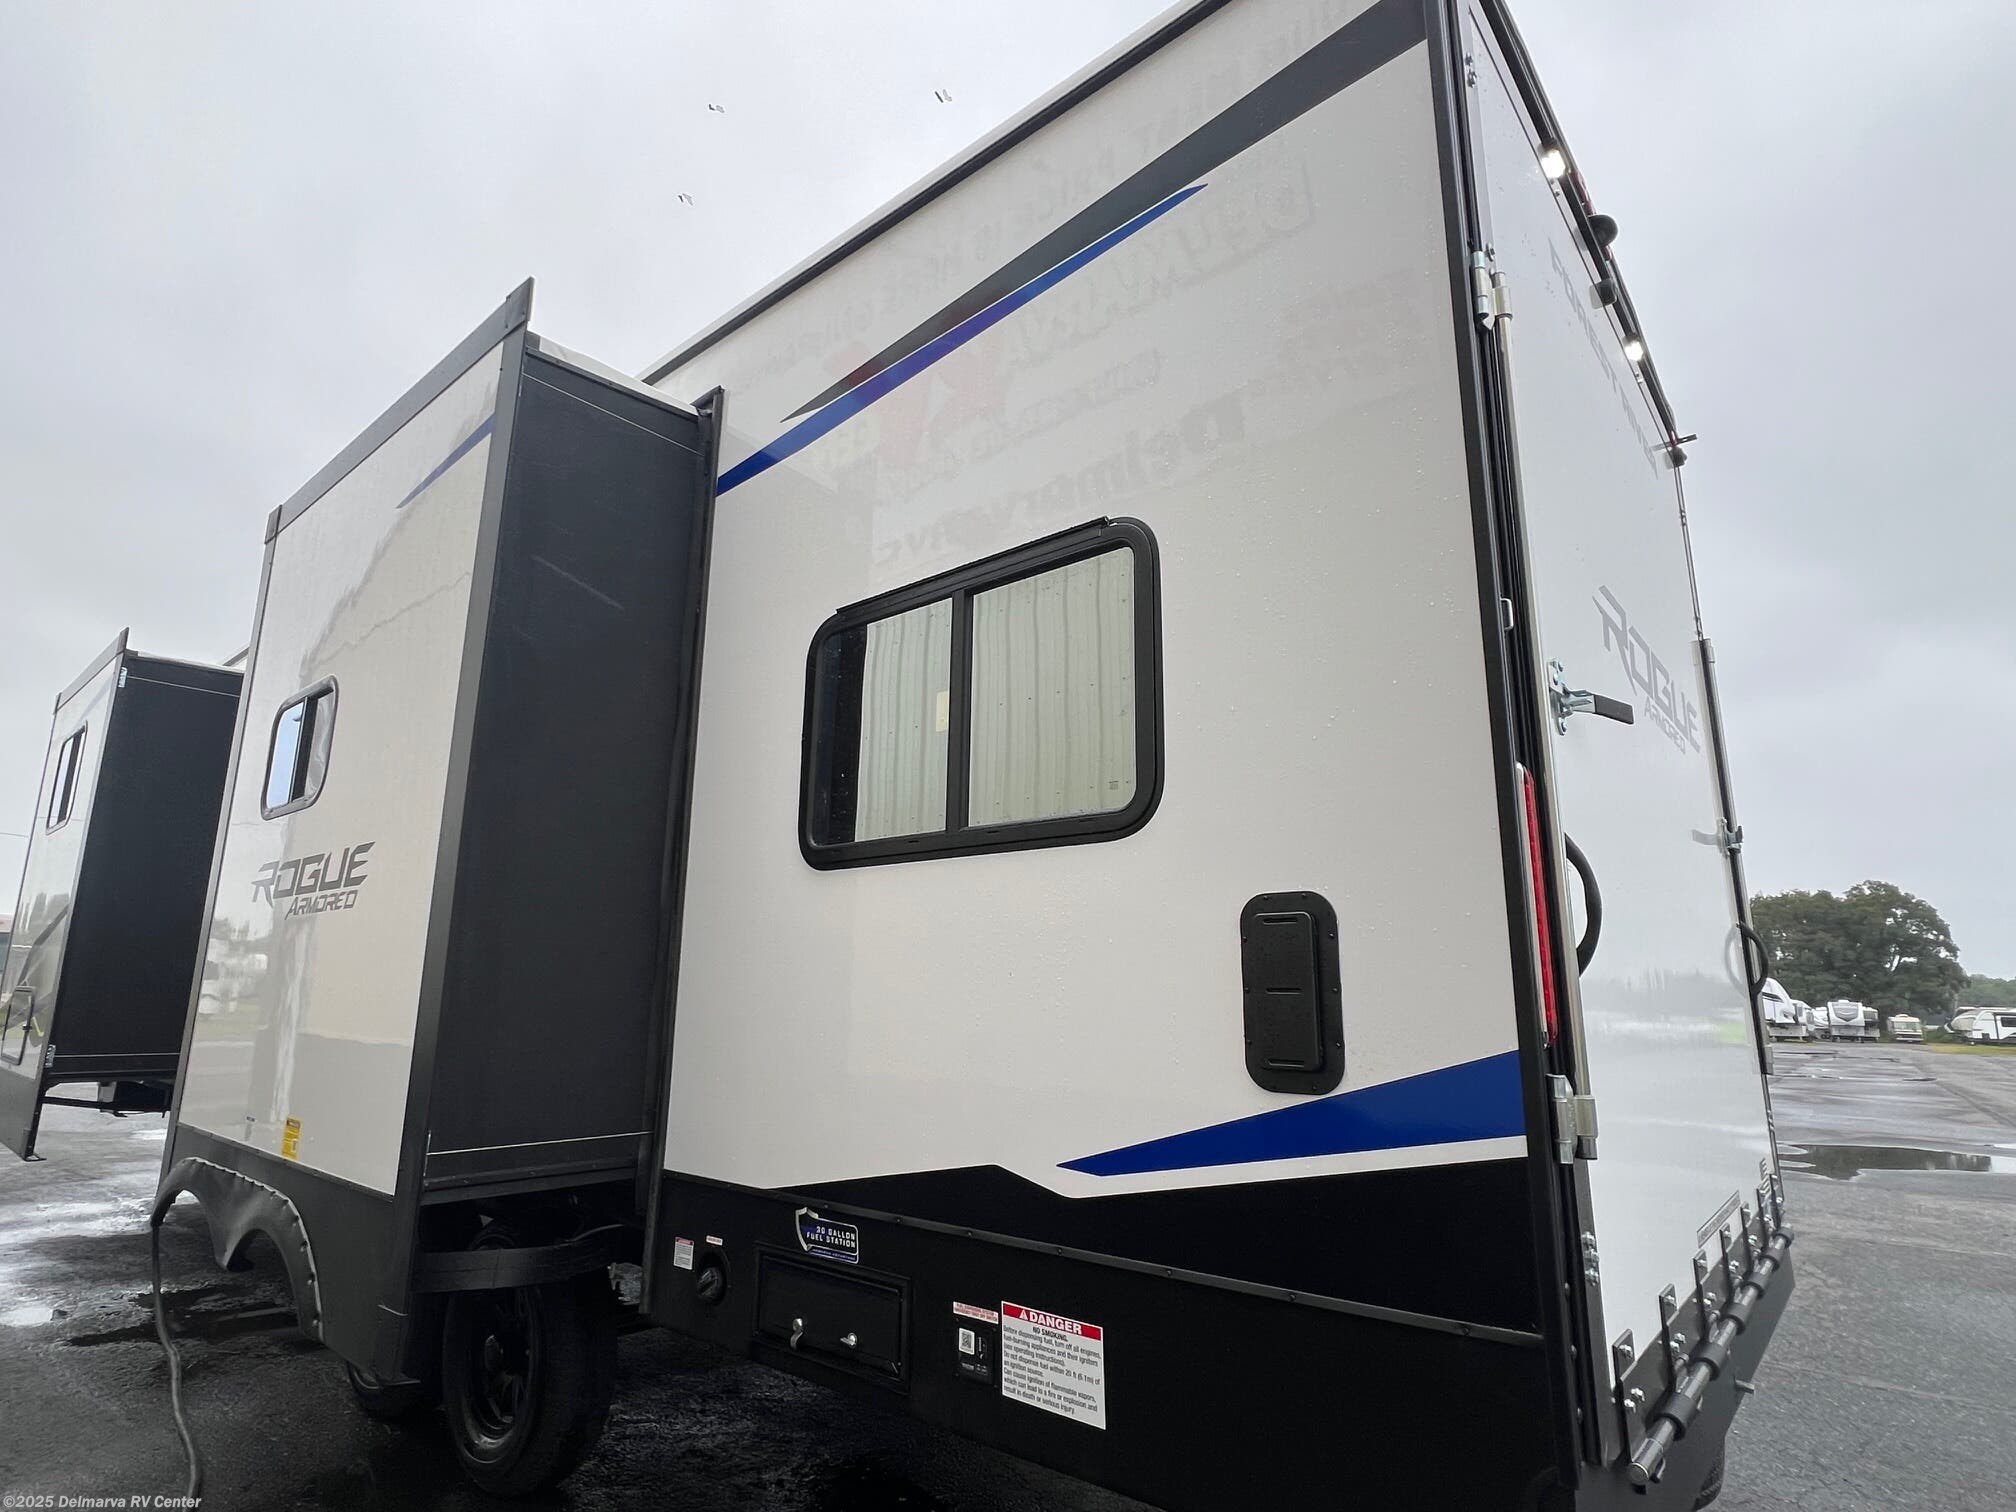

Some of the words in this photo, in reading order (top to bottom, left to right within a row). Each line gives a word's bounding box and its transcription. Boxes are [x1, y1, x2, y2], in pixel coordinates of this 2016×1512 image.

[1592, 584, 1701, 754] ROGUE
[251, 841, 376, 909] ROGUE
[284, 889, 359, 920] ARMORED
[806, 1232, 823, 1241] FUEL
[826, 1235, 856, 1248] STATION
[1029, 1312, 1082, 1335] DANGER
